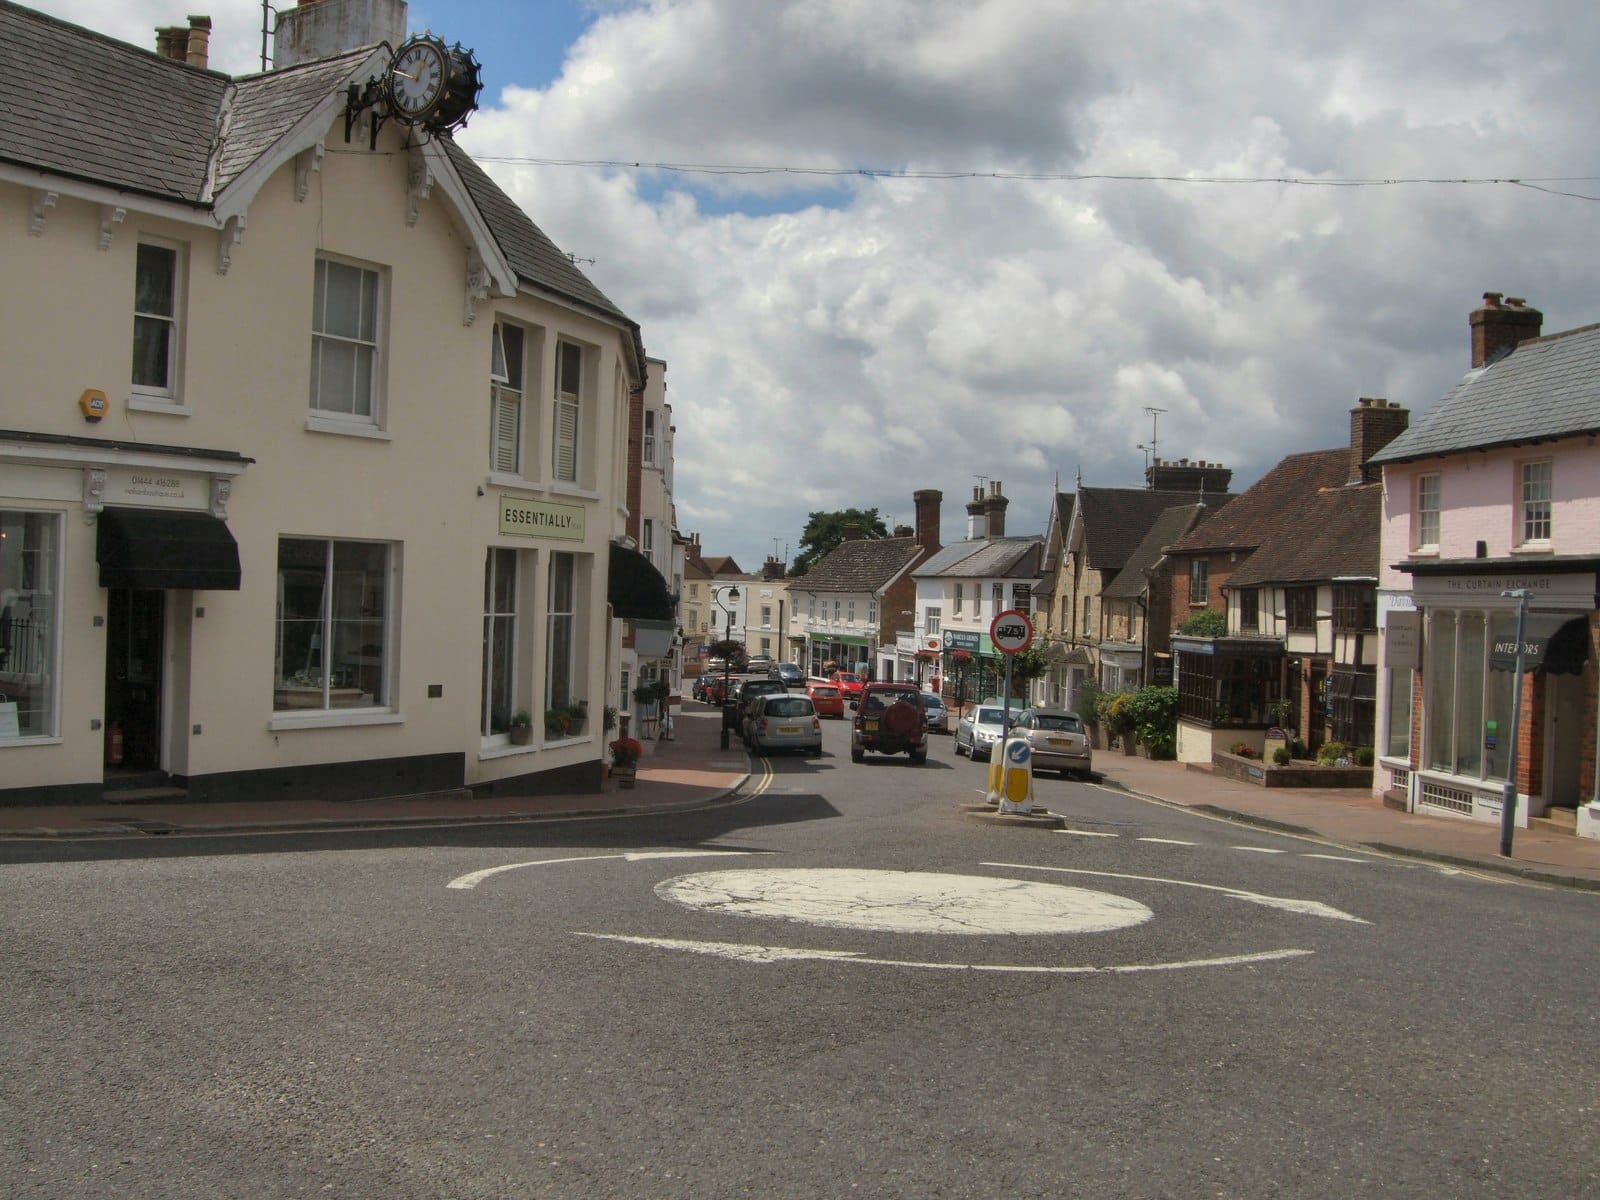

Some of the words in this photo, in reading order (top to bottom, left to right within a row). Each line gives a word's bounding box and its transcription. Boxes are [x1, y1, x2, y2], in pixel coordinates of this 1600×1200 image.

[505, 508, 572, 529] ESSENTIALLY
[1447, 580, 1460, 589] THE
[1465, 579, 1501, 590] CURTAIN
[1506, 578, 1552, 589] EXCHANGE
